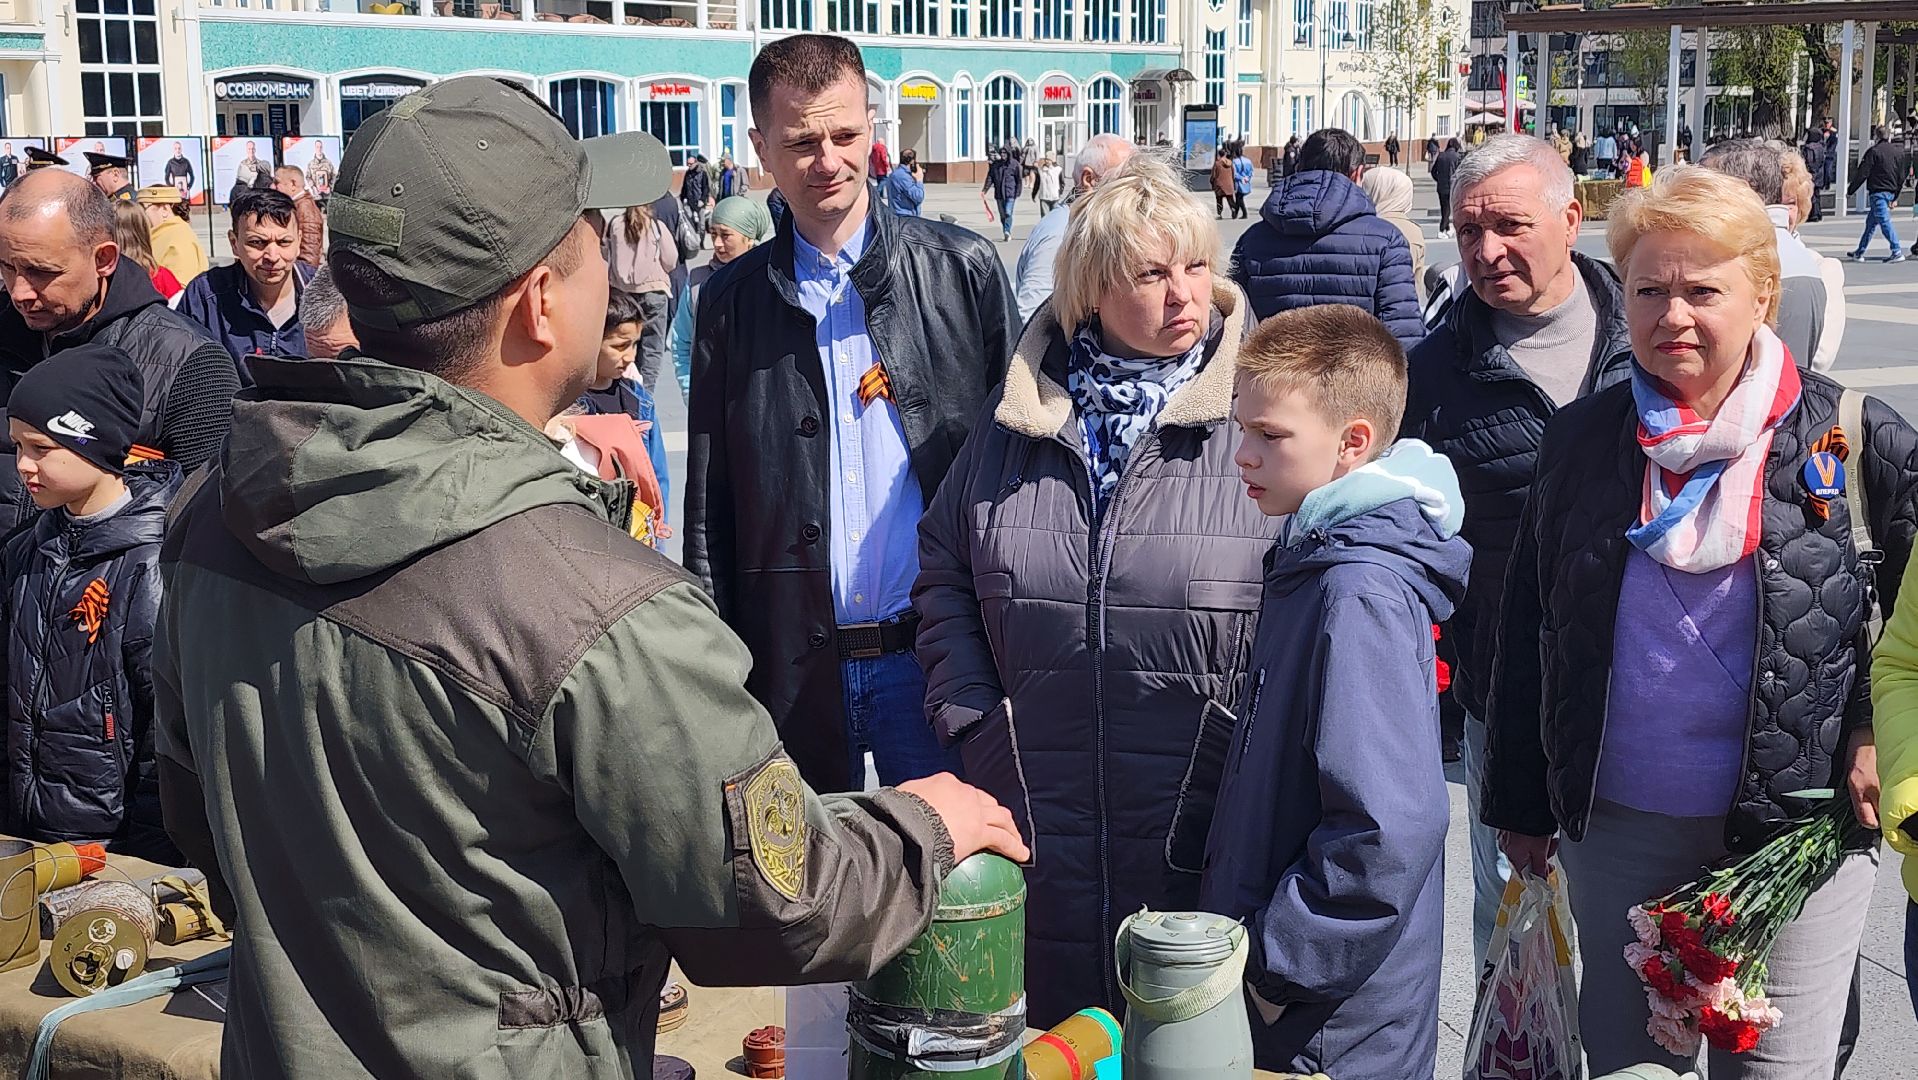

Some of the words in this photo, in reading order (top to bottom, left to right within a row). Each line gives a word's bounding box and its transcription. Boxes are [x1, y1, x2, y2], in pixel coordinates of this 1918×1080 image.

[227, 82, 310, 96] СОВКОМБАНК
[341, 85, 369, 96] ЦВЕТ
[60, 410, 95, 434] NIKE
[1813, 453, 1836, 487] V
